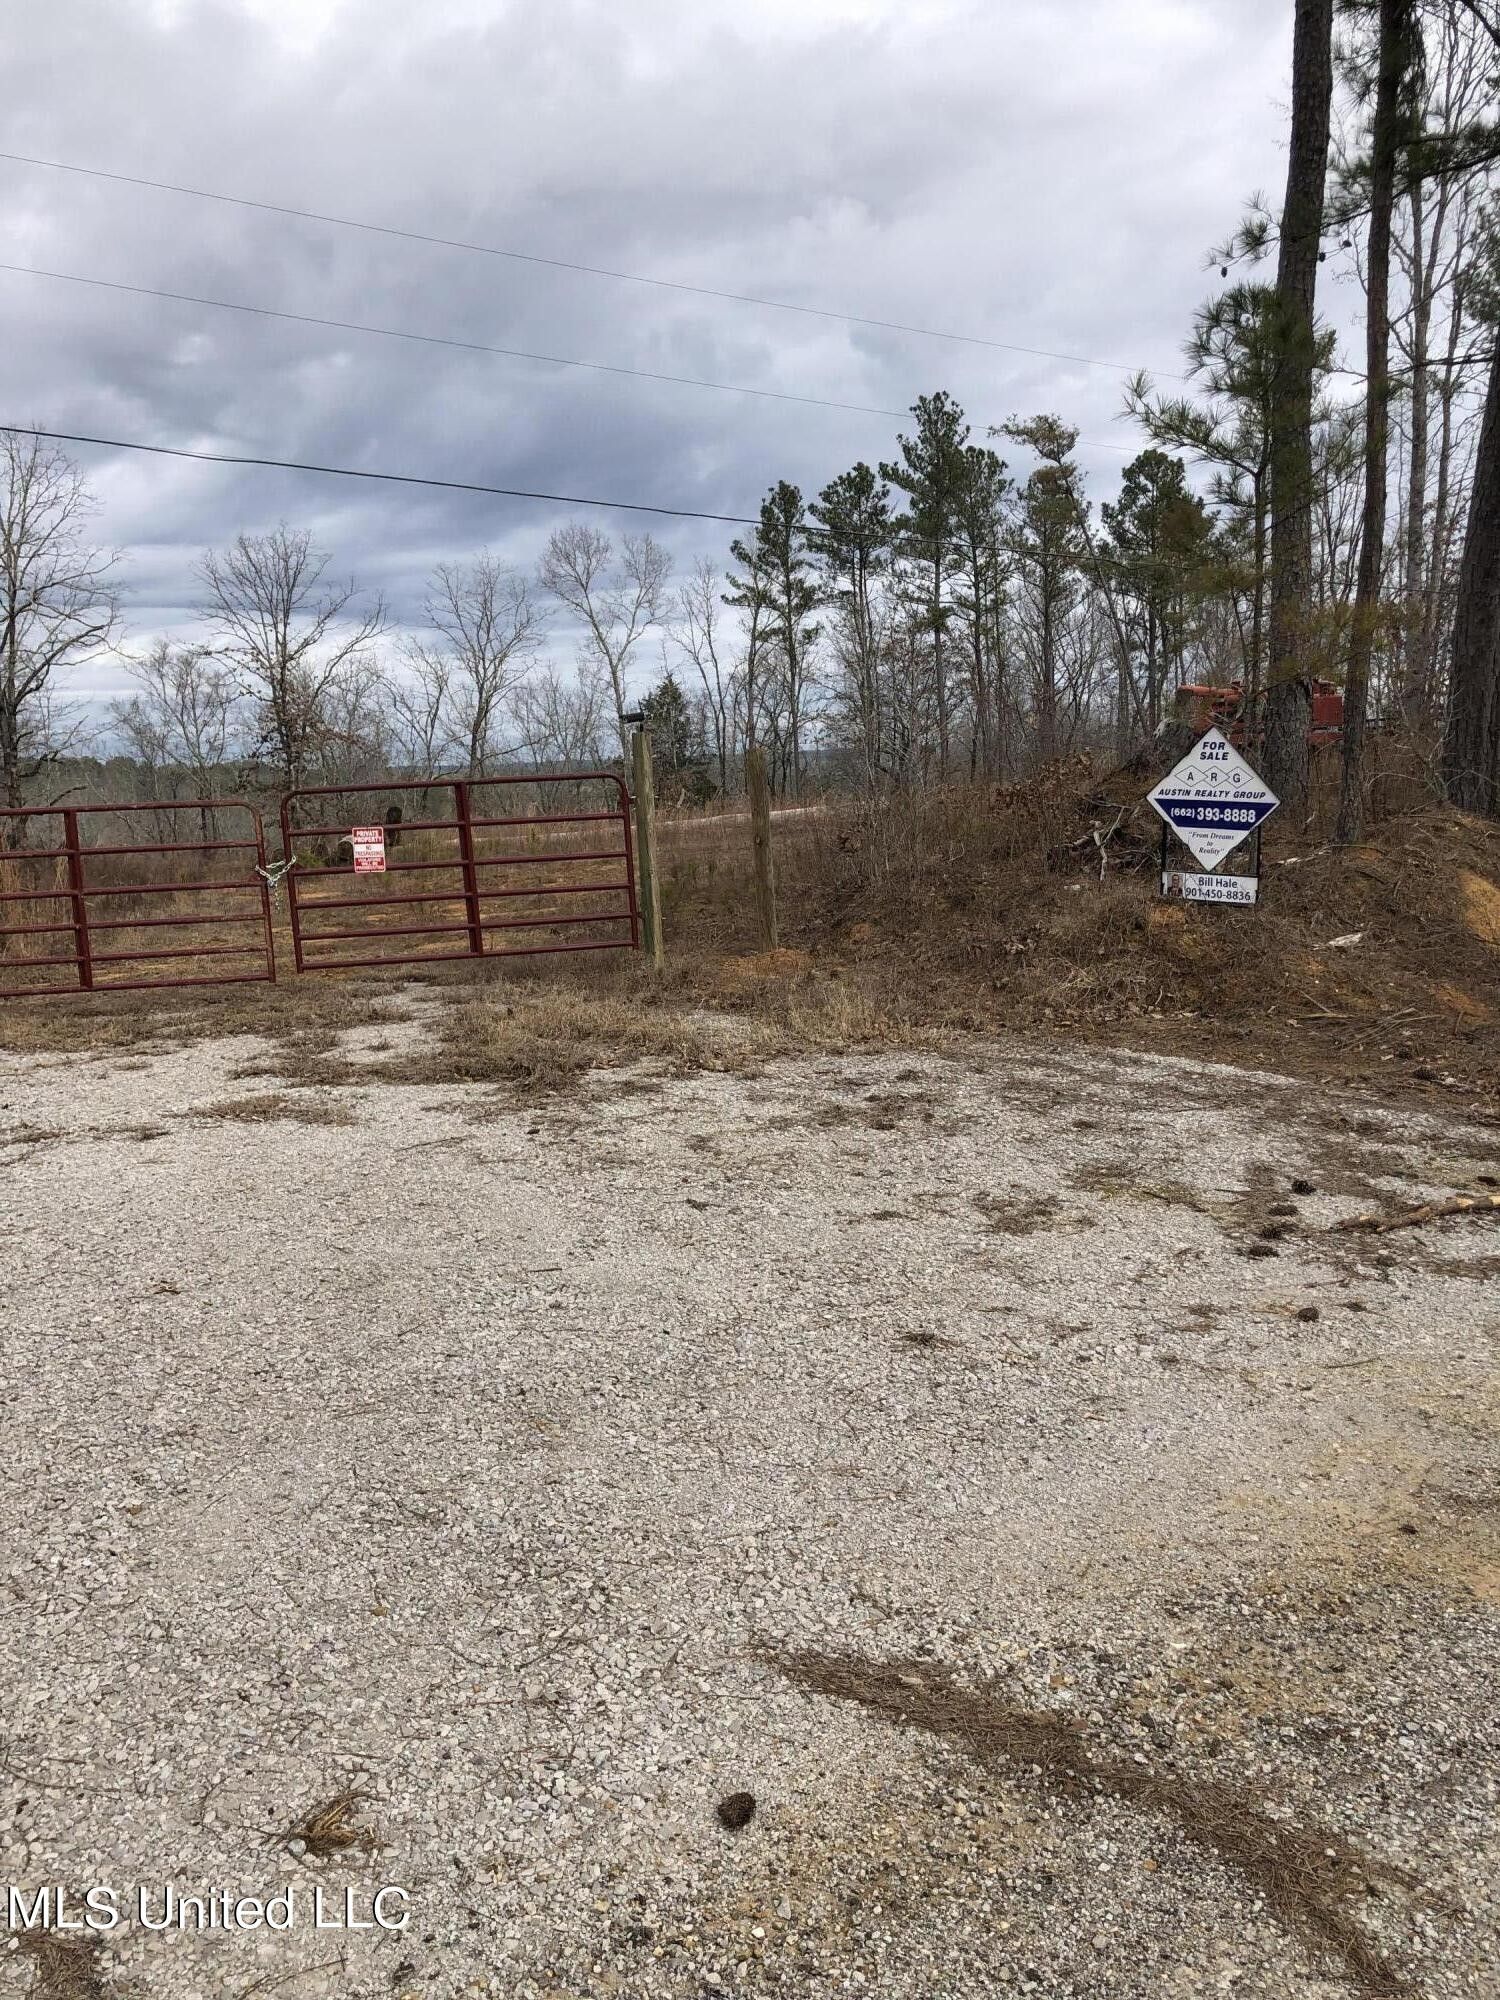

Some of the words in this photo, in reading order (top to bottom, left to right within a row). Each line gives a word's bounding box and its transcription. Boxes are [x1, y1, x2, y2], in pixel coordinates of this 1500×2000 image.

[1202, 741, 1225, 750] FOR
[1200, 752, 1229, 760] SALE
[1187, 772, 1194, 781] A
[1210, 772, 1218, 782] R
[1232, 773, 1240, 783] G
[1158, 788, 1191, 797] AUSTIN
[1195, 790, 1230, 798] REALTY
[1233, 791, 1266, 800] GROUP
[1170, 807, 1195, 818] (662)
[1197, 807, 1256, 823] 393-8888
[1210, 832, 1234, 840] Dreams
[1198, 877, 1213, 887] Bill
[1215, 877, 1238, 888] Hale
[1186, 887, 1251, 901] 901-450-8836
